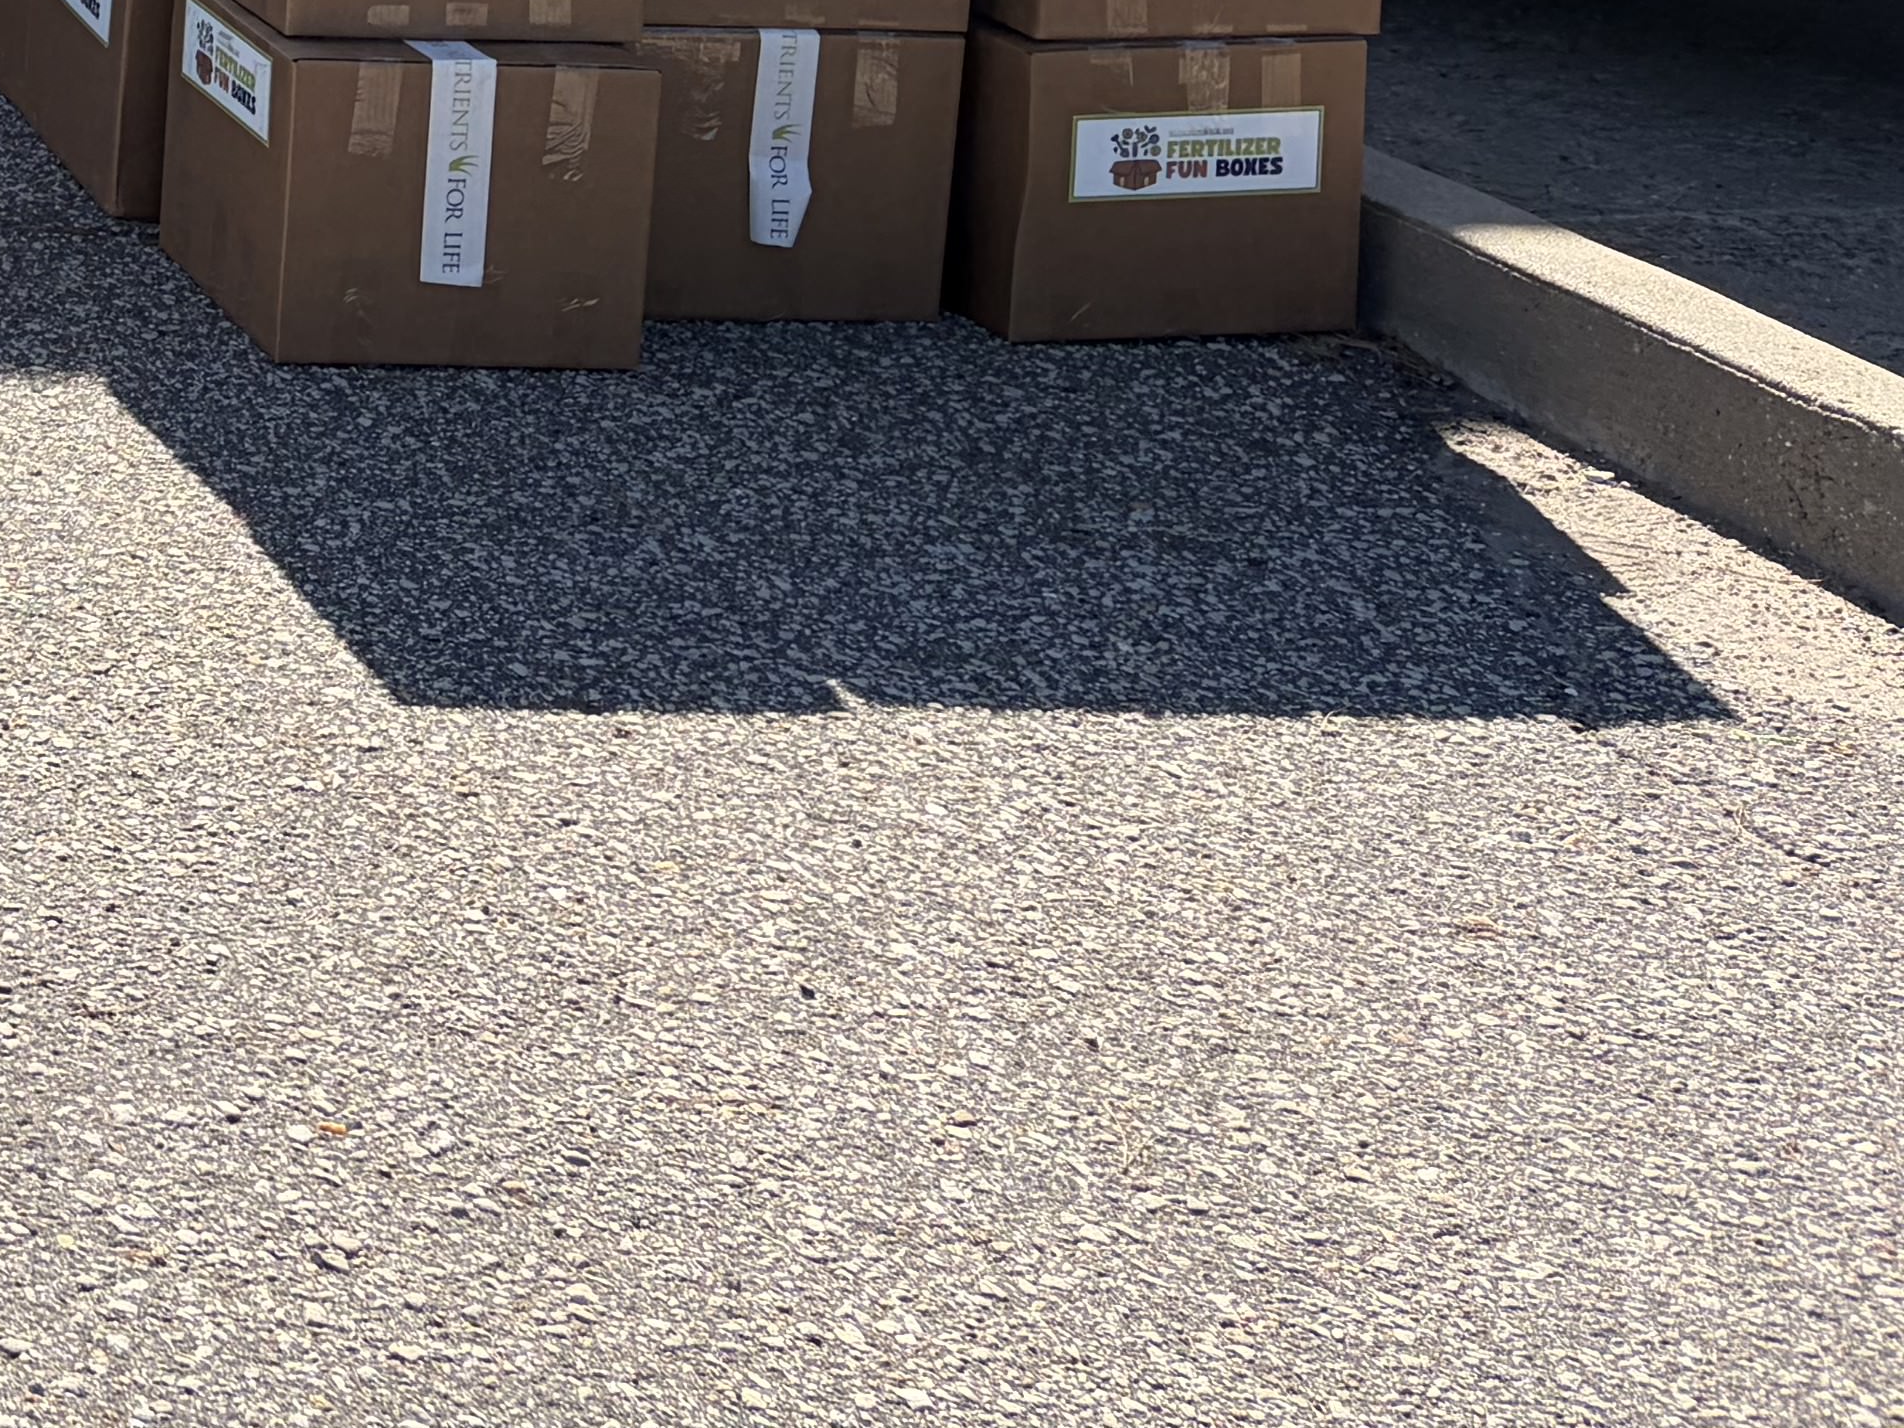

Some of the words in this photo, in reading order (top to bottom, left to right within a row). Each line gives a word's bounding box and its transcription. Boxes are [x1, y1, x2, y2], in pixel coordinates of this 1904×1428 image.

[774, 32, 798, 121] TRIENTS
[449, 60, 473, 152] TRIENTS
[768, 145, 789, 189] FOR
[1166, 160, 1208, 179] FUN
[1215, 157, 1283, 177] BOXES
[1167, 137, 1281, 158] FERTILIZER
[445, 178, 467, 224] FOR
[770, 199, 791, 239] LIFE
[442, 232, 463, 274] LIFE
